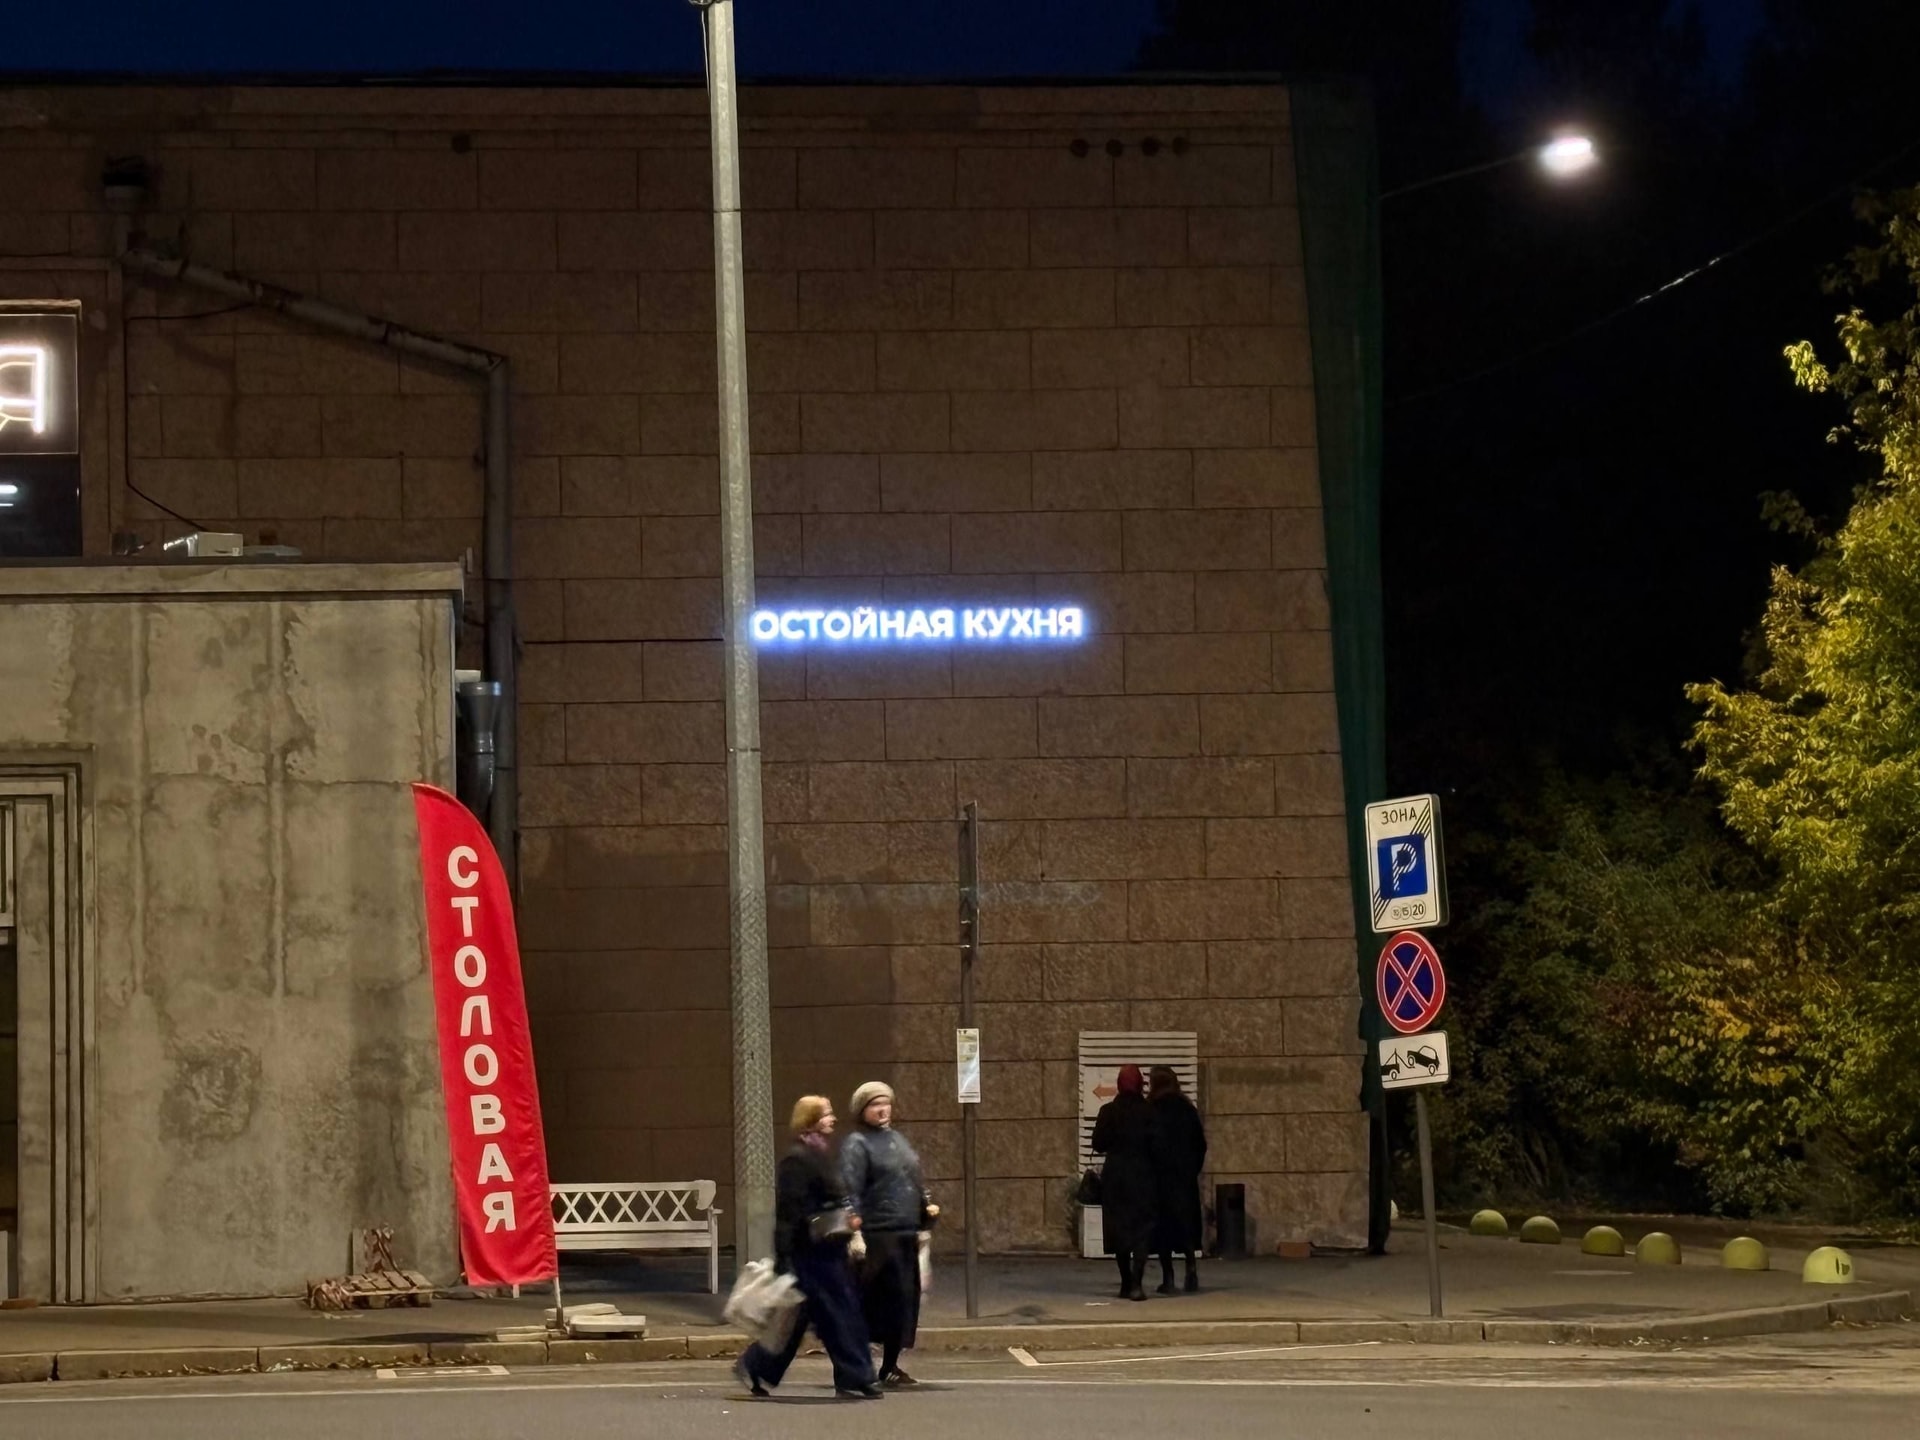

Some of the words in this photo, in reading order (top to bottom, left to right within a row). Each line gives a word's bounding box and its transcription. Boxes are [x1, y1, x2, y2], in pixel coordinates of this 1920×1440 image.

[753, 606, 954, 639] ОСТОЙНАЯ
[963, 607, 1082, 638] КУХНЯ
[1381, 806, 1418, 825] ЗОНА
[1412, 903, 1424, 916] 20
[448, 844, 517, 1234] СТОЛОВАЯ
